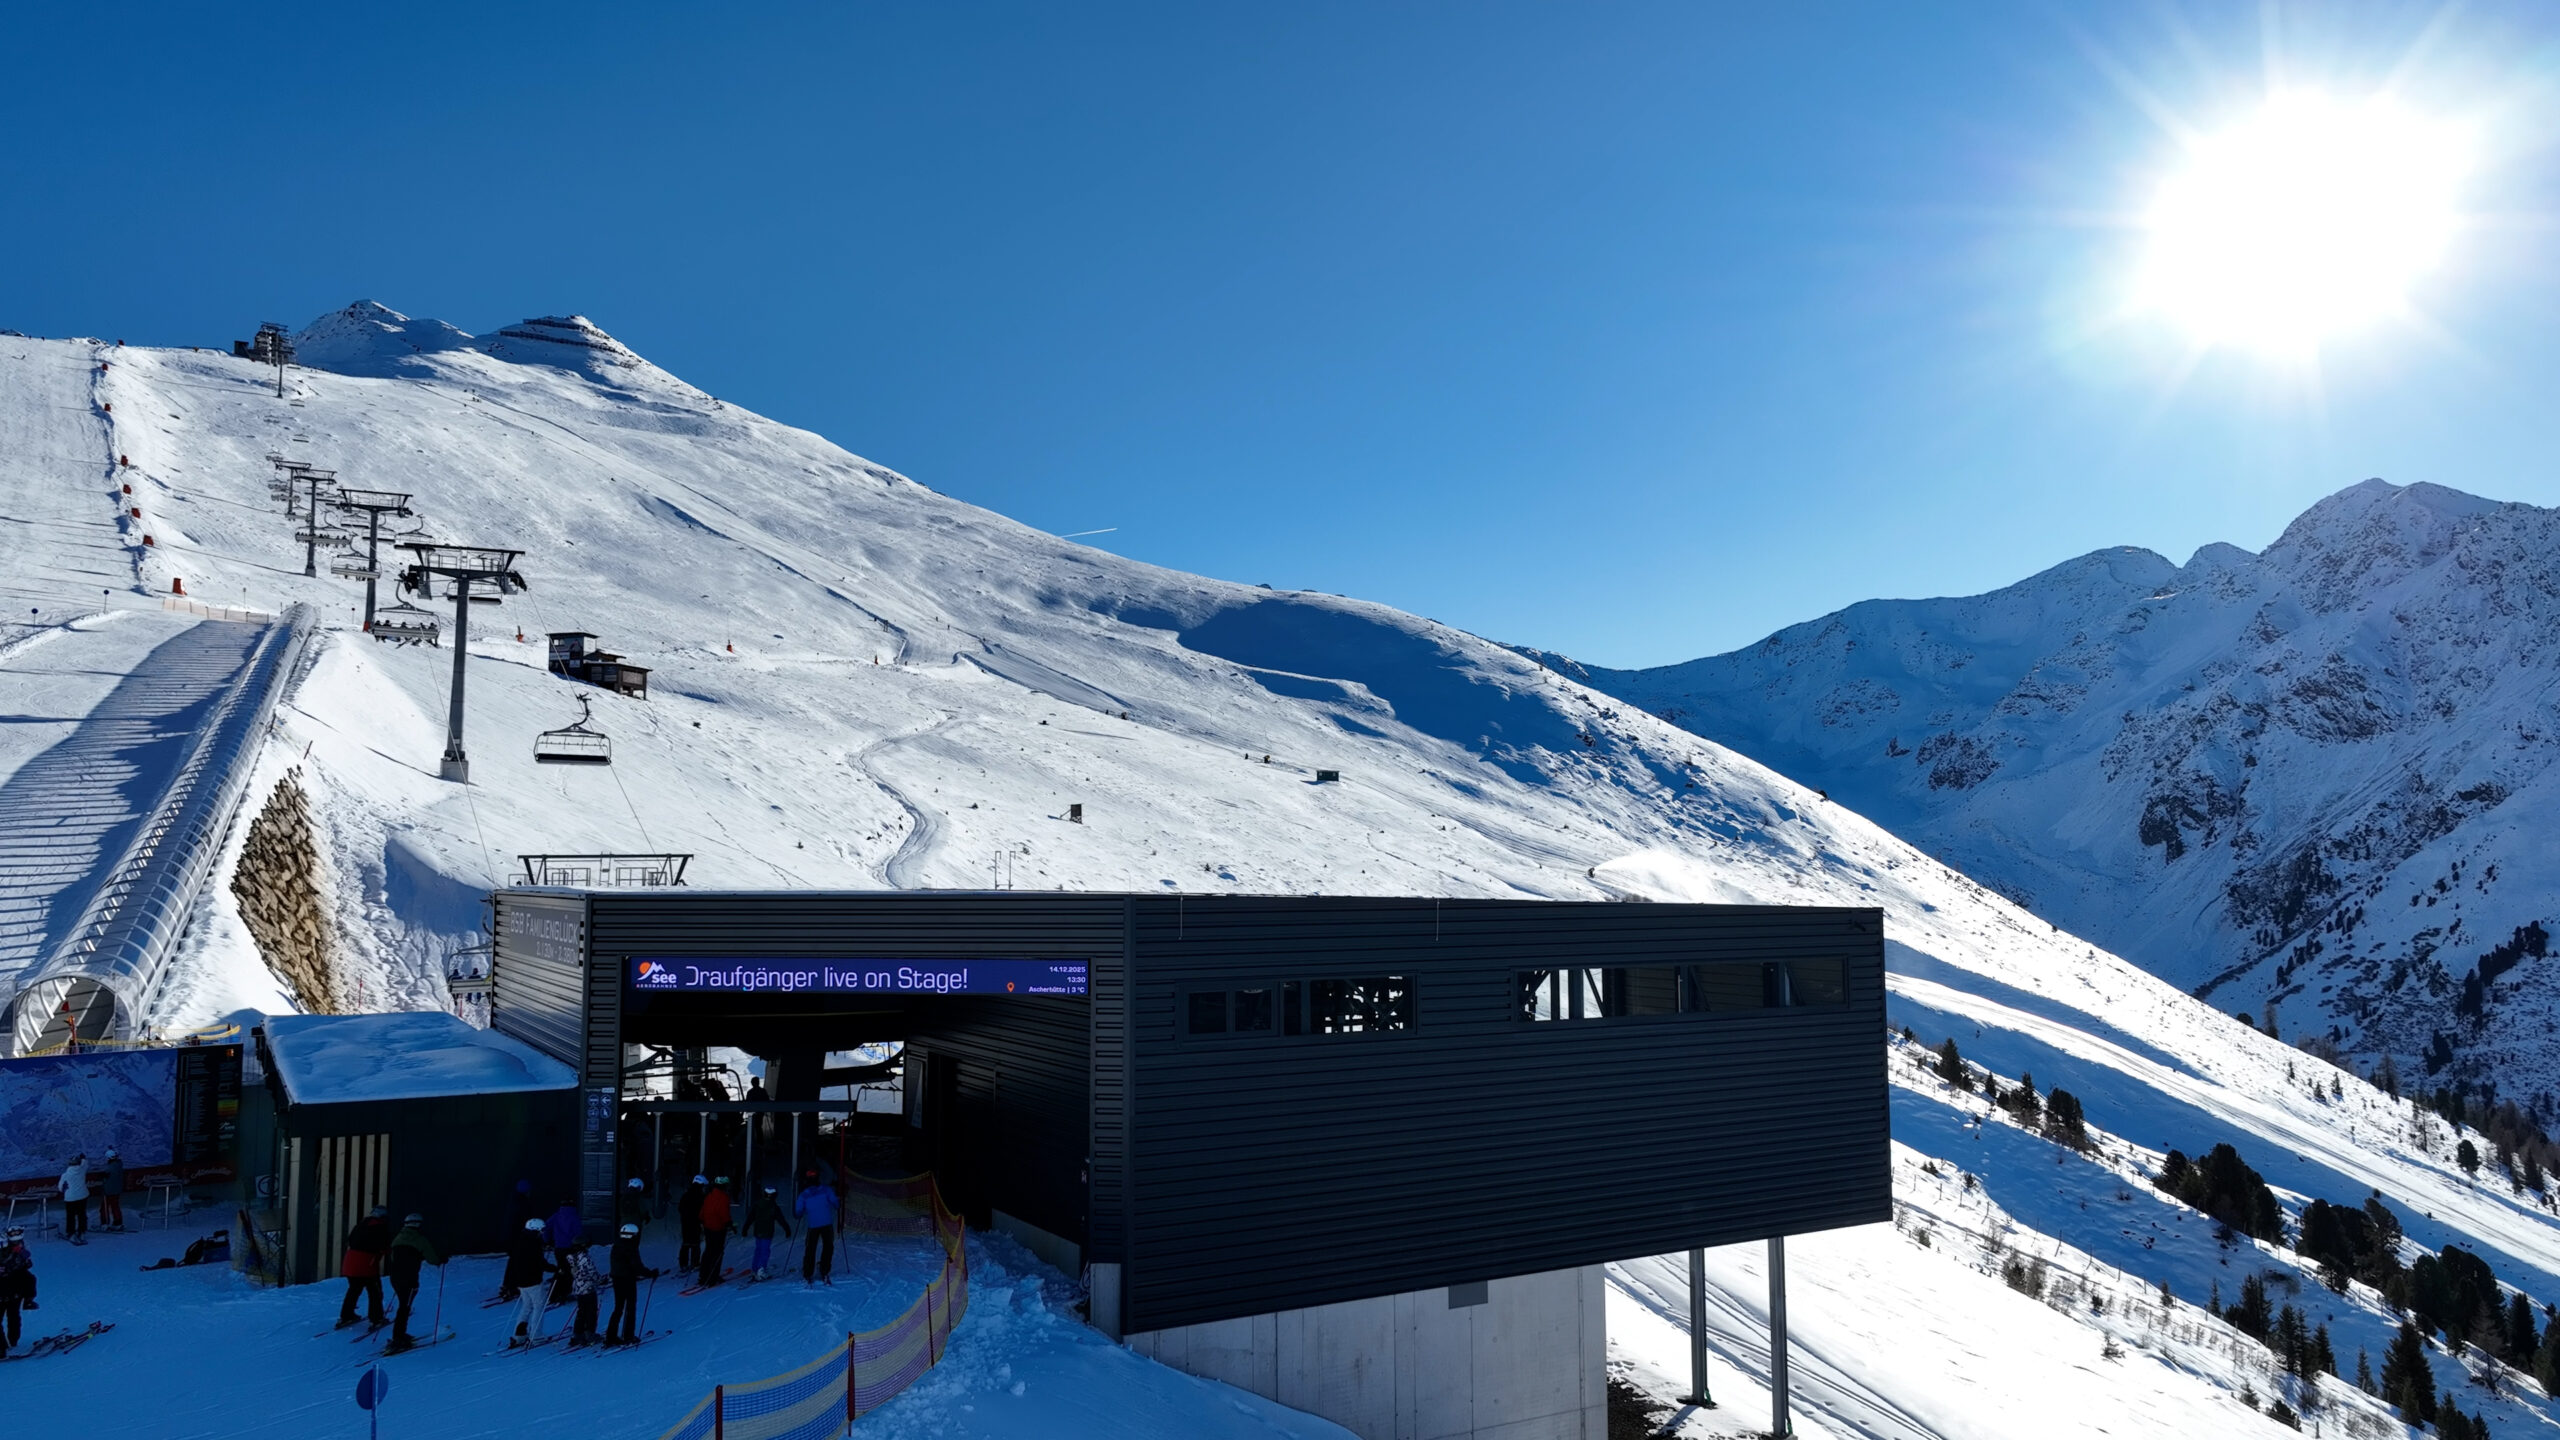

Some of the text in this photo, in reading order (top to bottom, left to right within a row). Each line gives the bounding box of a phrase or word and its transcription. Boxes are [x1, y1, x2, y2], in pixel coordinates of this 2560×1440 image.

[526, 913, 579, 945] FAMILIENGLÜCK
[651, 973, 677, 984] see
[685, 966, 968, 993] Draufgänger live on Stage!
